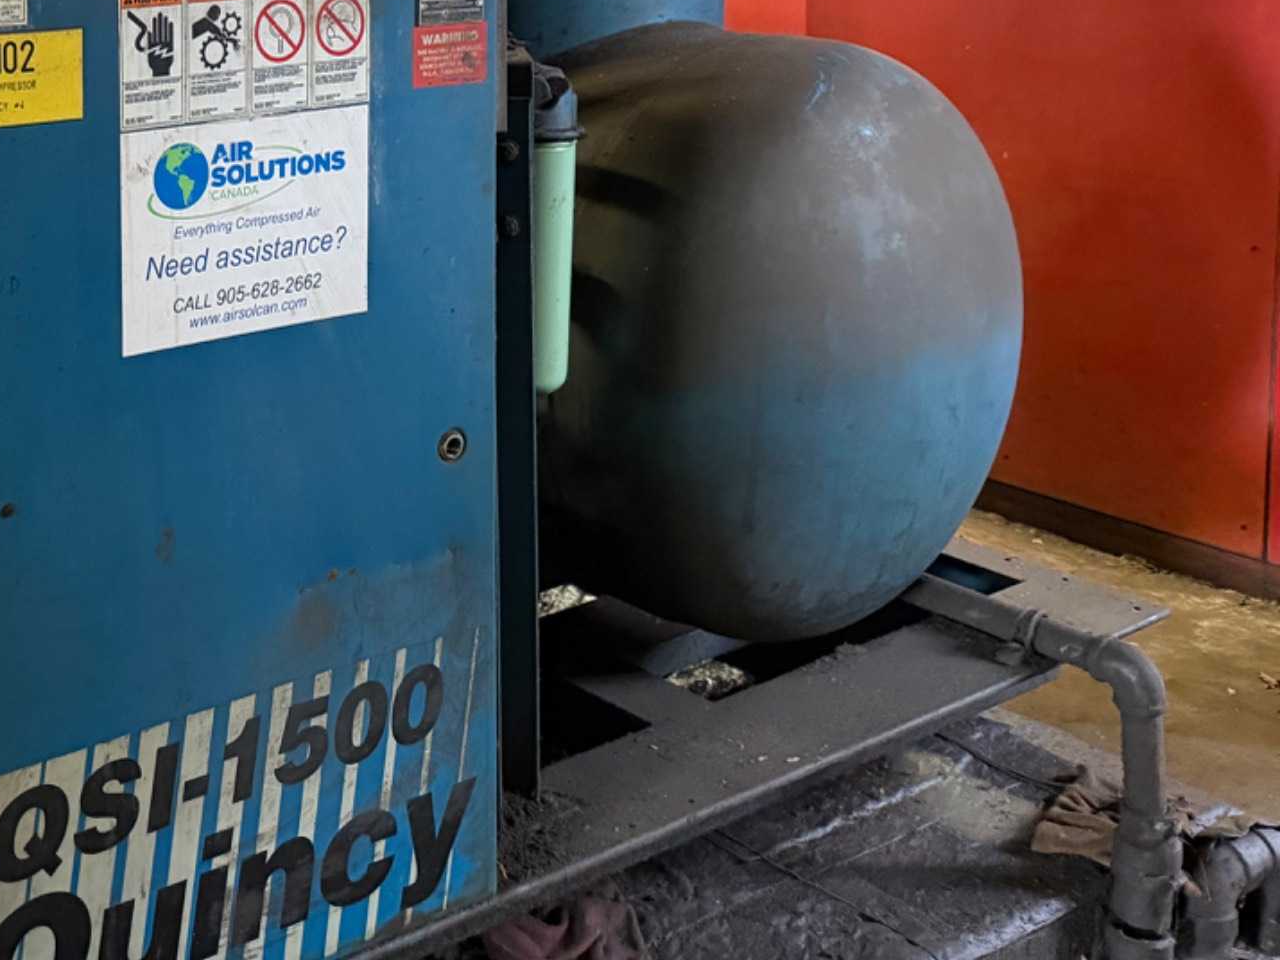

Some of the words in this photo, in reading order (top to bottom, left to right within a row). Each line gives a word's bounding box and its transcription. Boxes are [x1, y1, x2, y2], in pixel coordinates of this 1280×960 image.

[211, 140, 253, 165] AIR
[211, 150, 346, 188] SOLUTIONS
[210, 185, 259, 201] CANADA
[174, 220, 233, 240] Everything
[236, 210, 304, 231] Compressed
[306, 206, 321, 218] Air
[145, 247, 209, 281] Need
[216, 225, 348, 269] assistance?
[173, 295, 211, 314] CALL
[217, 272, 322, 306] 905-628-2662
[189, 296, 307, 329] www.airsolcan.com
